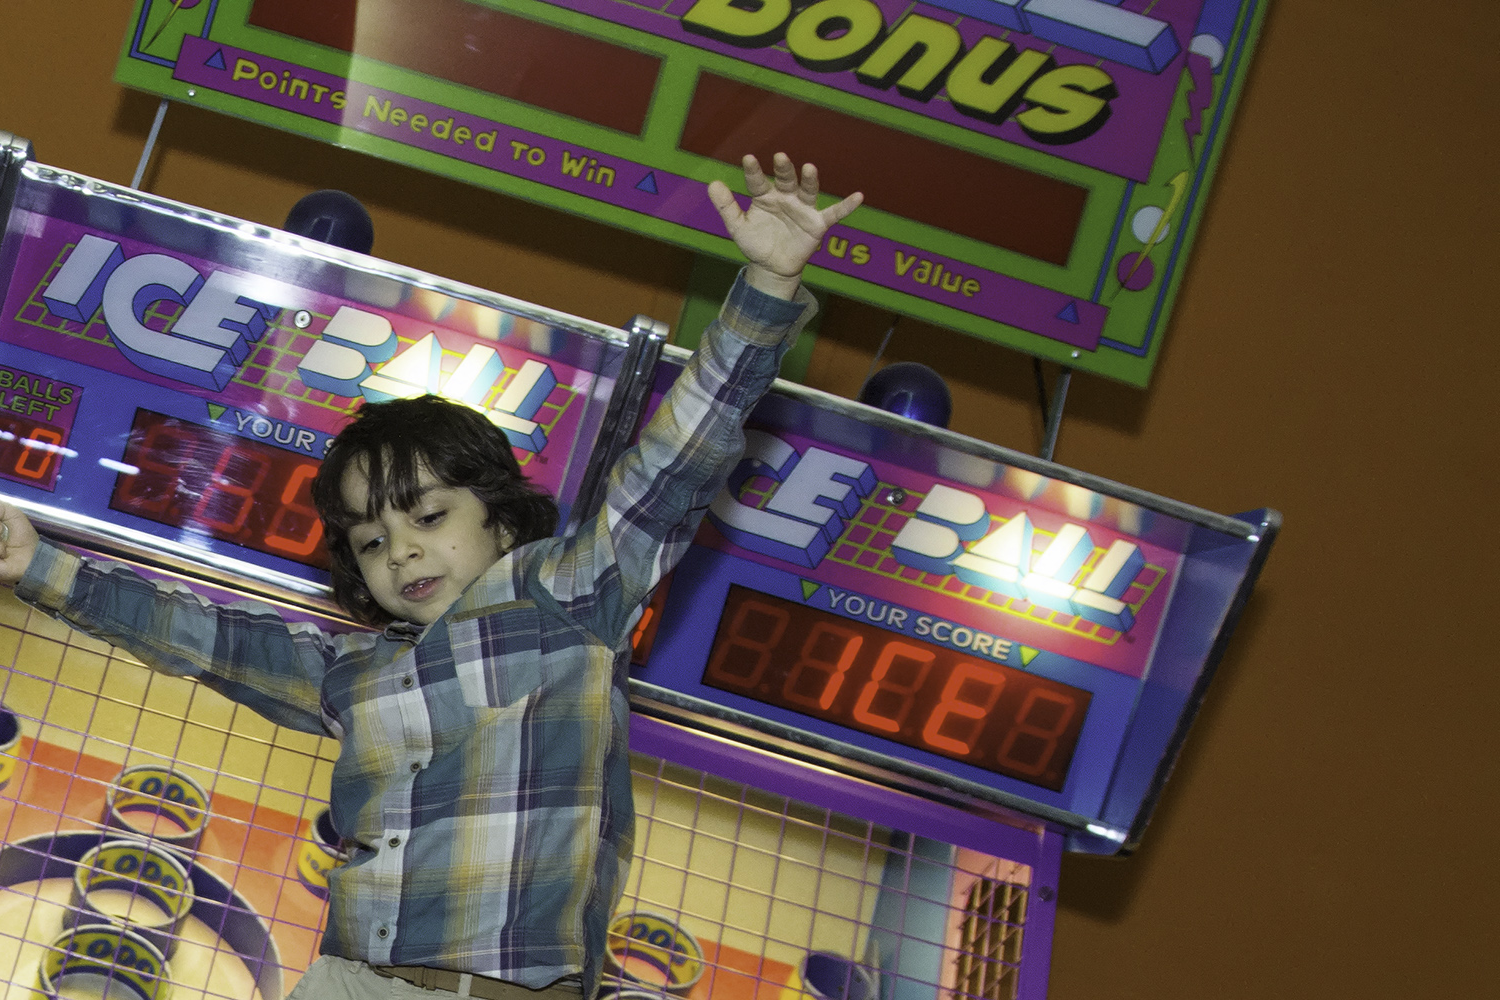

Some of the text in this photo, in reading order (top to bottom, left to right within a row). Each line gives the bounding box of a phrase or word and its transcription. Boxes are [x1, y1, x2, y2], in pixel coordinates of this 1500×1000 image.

[362, 93, 499, 154] Needed
[560, 150, 617, 189] Win
[893, 250, 982, 298] Value
[42, 233, 557, 452] ICE BALL
[15, 427, 62, 479] 0
[235, 411, 316, 452] YOUR
[707, 427, 1143, 632] CE BALL
[827, 588, 1013, 662] YOUR SCORE
